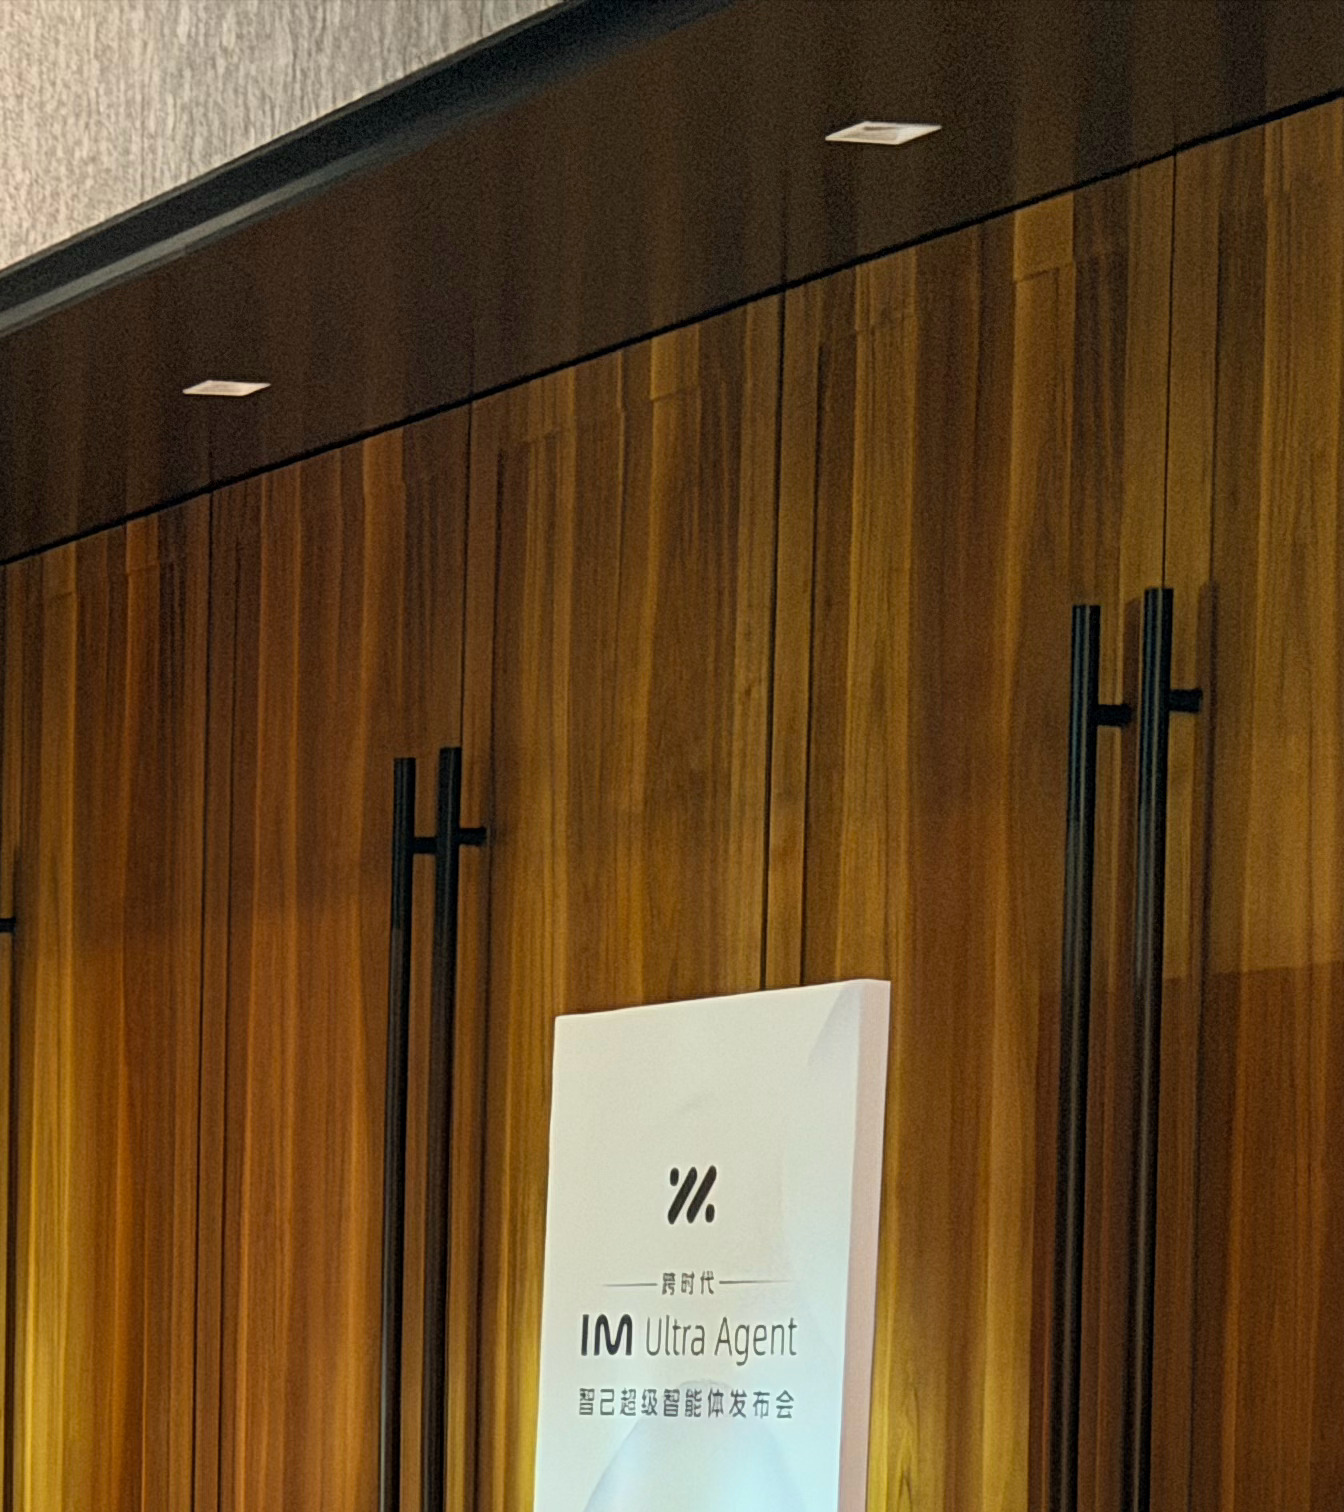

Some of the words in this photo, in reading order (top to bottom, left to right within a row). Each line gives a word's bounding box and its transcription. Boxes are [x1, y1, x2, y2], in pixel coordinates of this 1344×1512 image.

[662, 1270, 715, 1296] 跨时代
[580, 1313, 633, 1356] IM
[645, 1314, 706, 1357] Ultra
[714, 1316, 798, 1366] Agent
[578, 1387, 795, 1419] 智己超级智能体发布会
